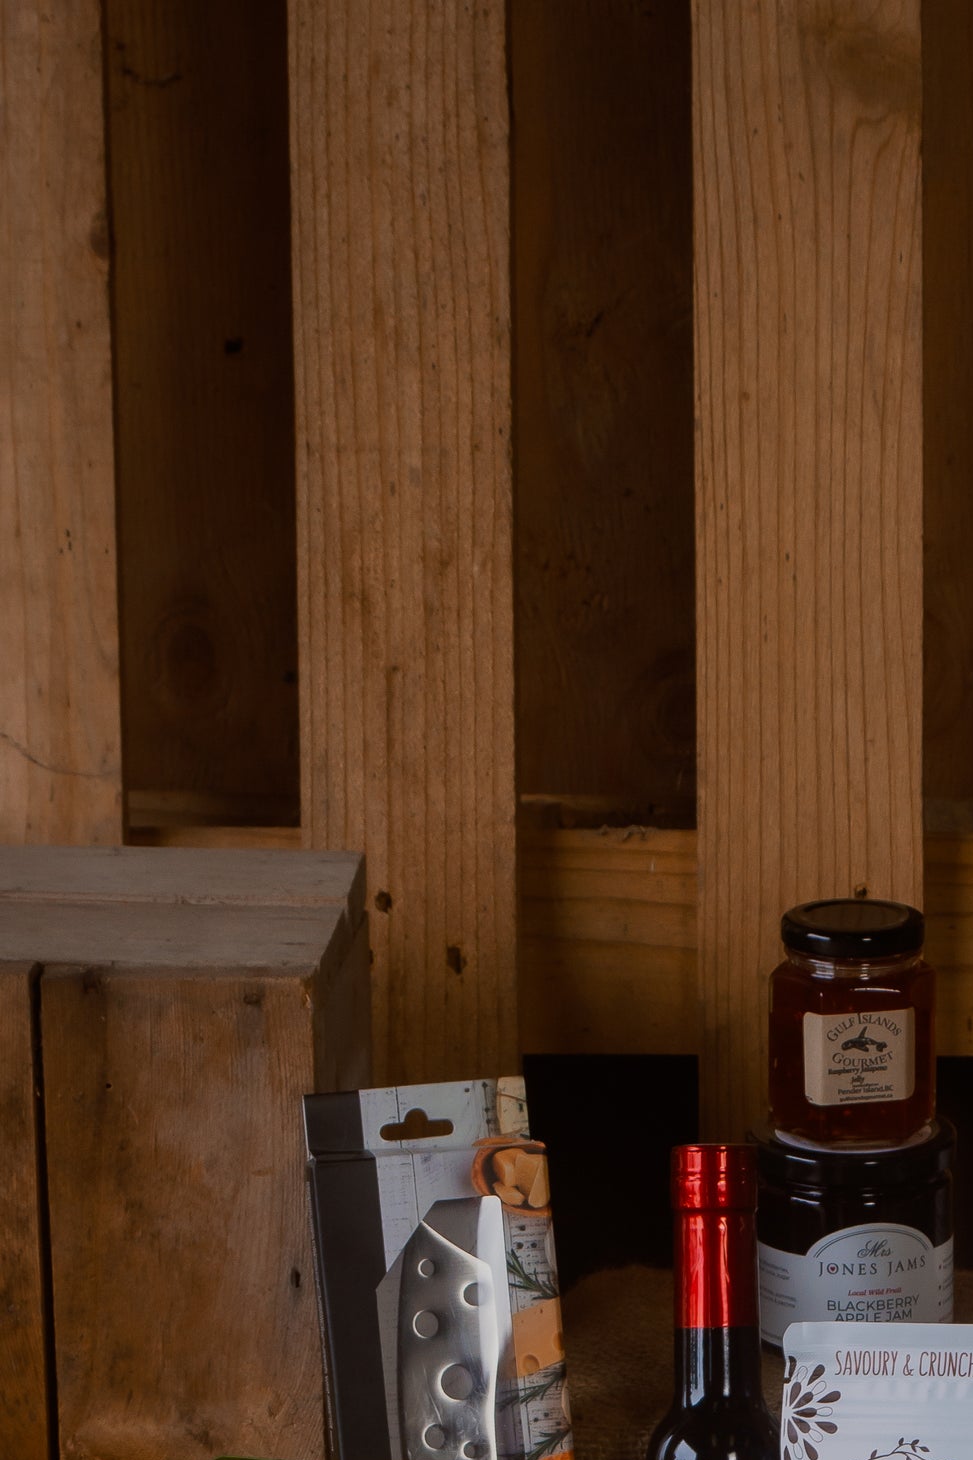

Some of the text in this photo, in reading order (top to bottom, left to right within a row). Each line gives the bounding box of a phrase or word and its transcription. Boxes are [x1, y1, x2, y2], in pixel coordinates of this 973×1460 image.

[827, 1012, 902, 1041] GULF ISLANDS
[832, 1051, 893, 1067] GOURMET
[857, 1239, 892, 1258] Mrs
[818, 1255, 926, 1277] JONES JAMS
[868, 1288, 884, 1296] Wild
[886, 1287, 901, 1295] Fruit
[827, 1294, 919, 1311] BLACKBERRY
[835, 1308, 912, 1322] APPLE JAM
[835, 1350, 898, 1377] SAVOURY
[902, 1356, 914, 1376] &
